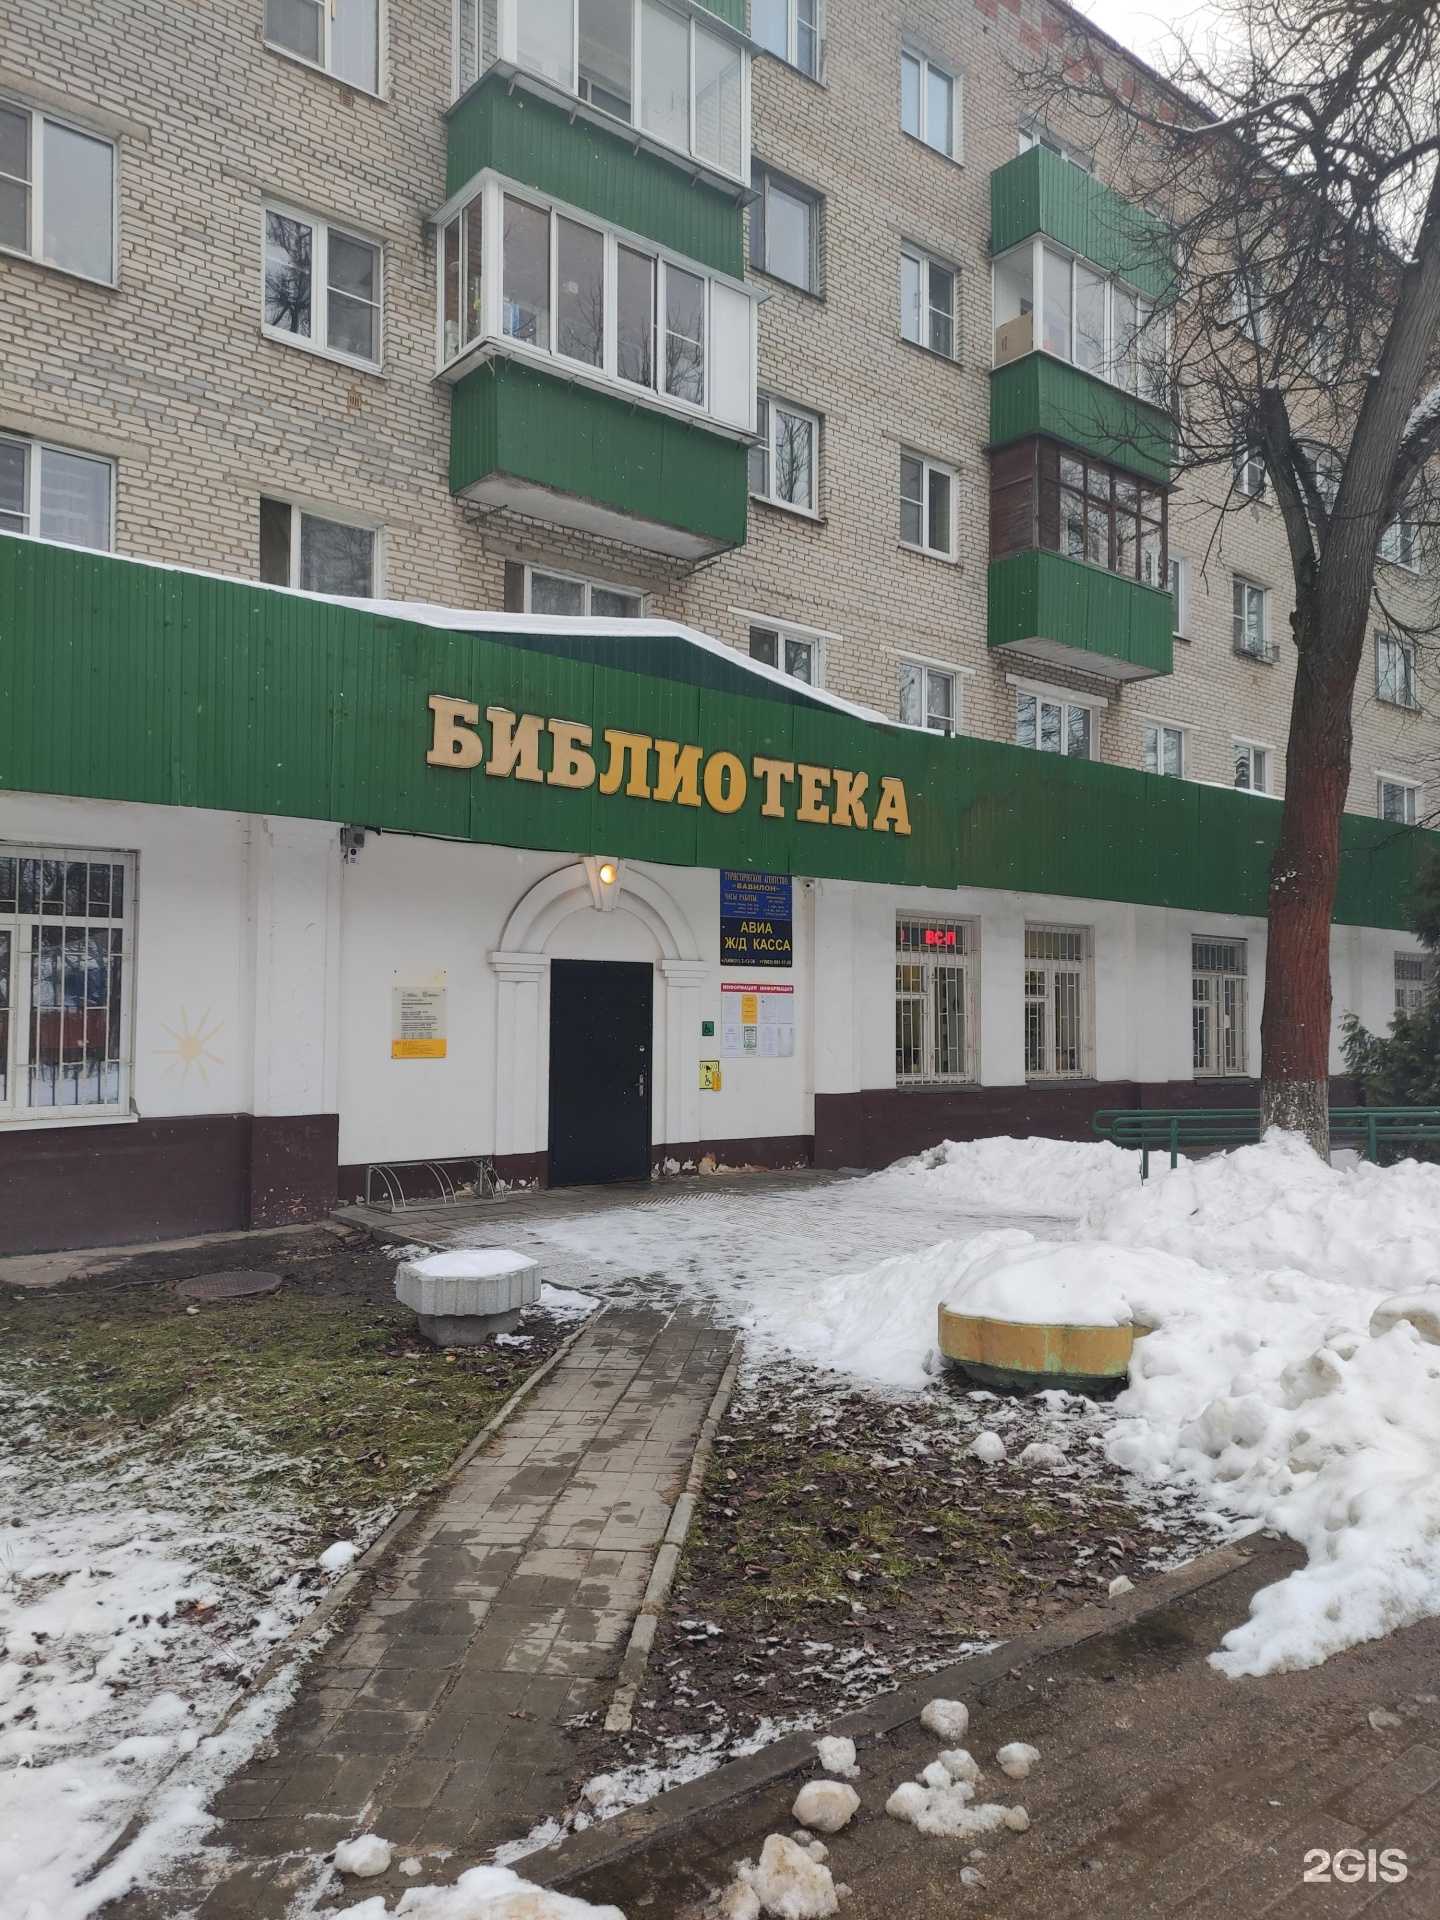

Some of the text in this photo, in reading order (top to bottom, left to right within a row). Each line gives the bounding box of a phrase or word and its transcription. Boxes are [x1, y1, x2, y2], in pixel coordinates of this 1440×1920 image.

[426, 694, 912, 836] БИБЛИОТЕКА
[740, 921, 773, 934] АВИА
[724, 936, 791, 951] Ж/Д КАССА
